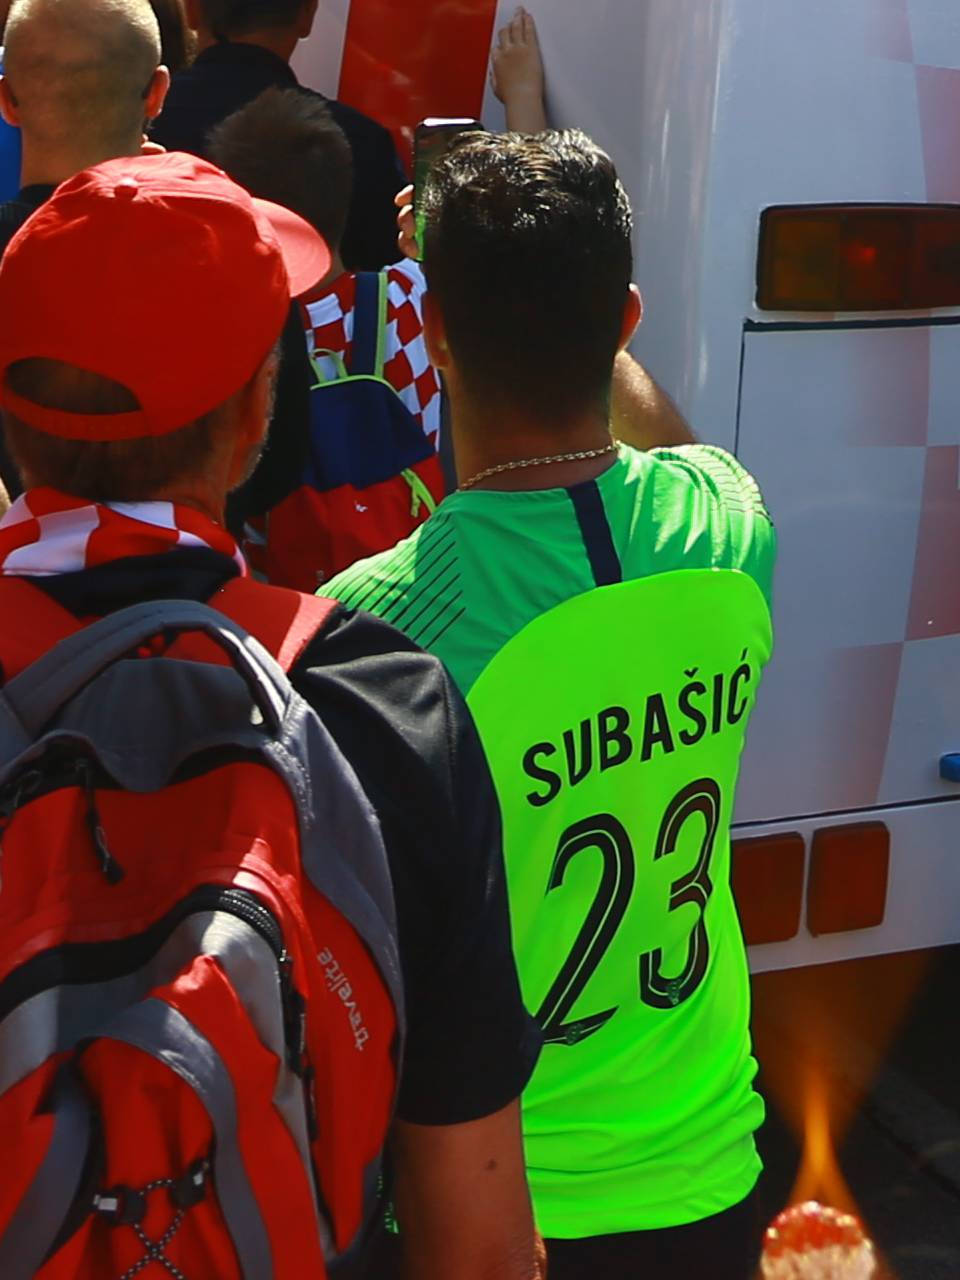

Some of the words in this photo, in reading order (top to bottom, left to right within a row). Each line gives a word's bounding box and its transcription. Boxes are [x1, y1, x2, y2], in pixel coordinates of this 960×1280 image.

[522, 648, 751, 807] SUBAŠIĆ
[541, 777, 721, 1046] 23
[317, 946, 370, 1050] travelite
